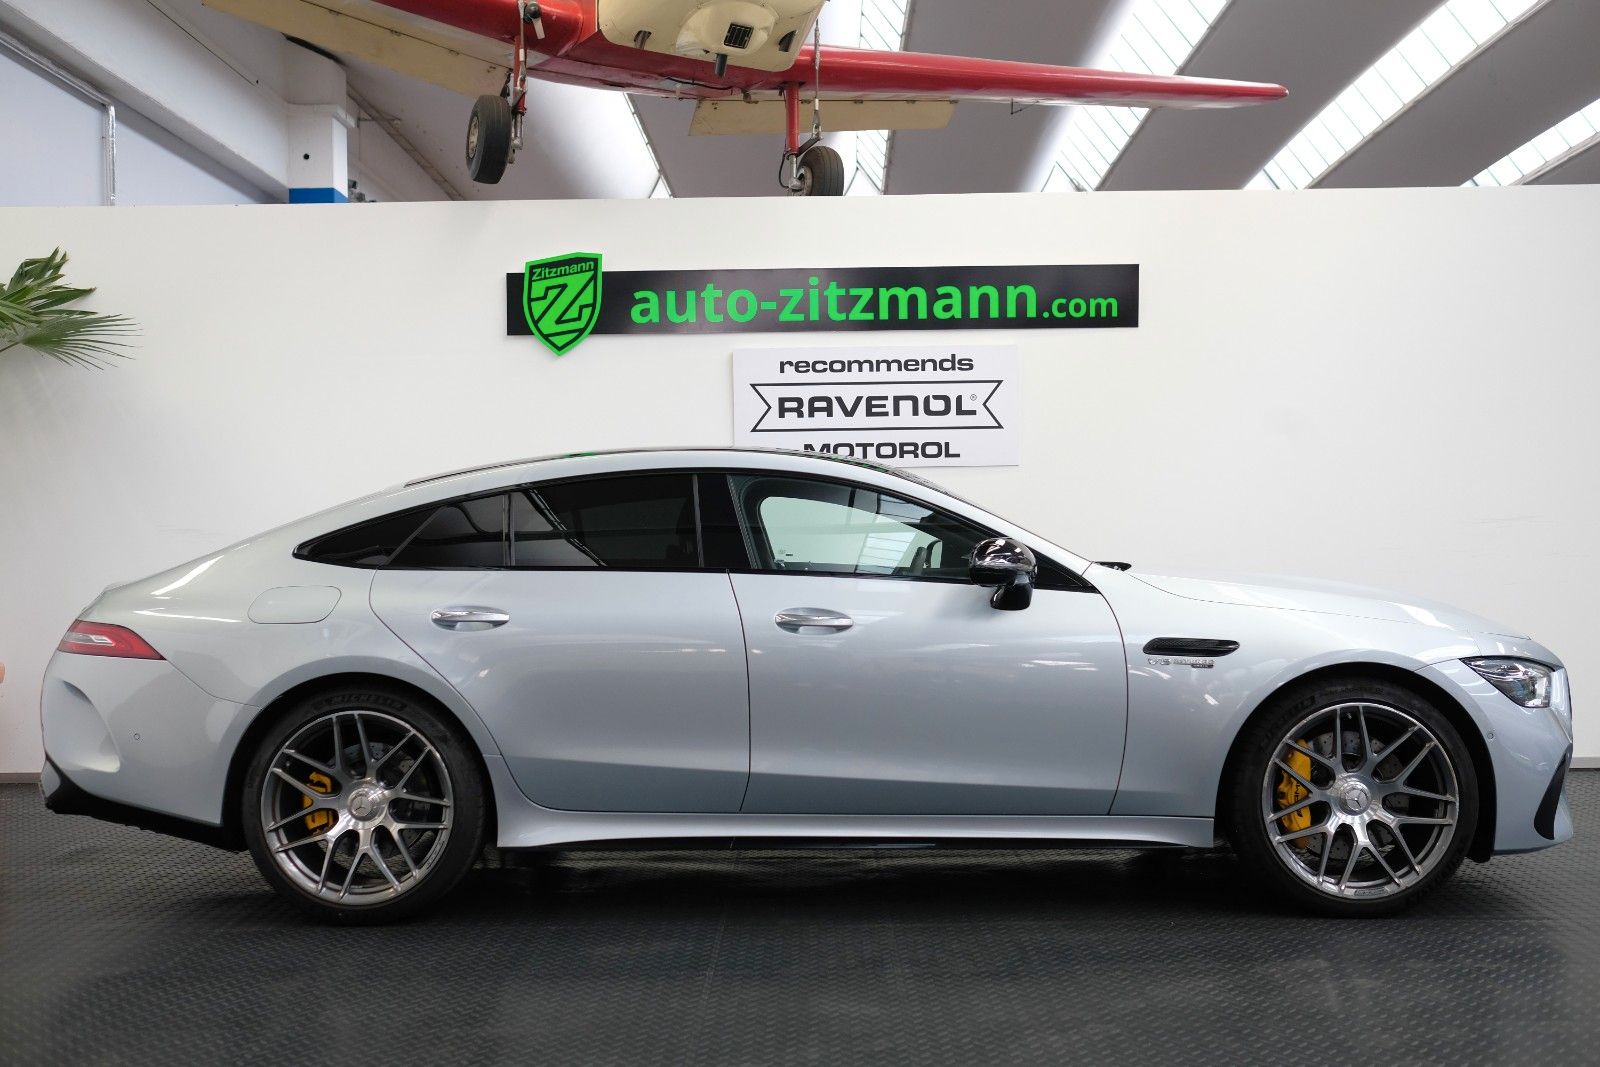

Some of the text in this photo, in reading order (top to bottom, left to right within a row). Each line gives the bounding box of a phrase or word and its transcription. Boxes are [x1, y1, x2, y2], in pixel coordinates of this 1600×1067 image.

[531, 260, 594, 281] Zitzmann
[630, 275, 1118, 325] auto-zitzmann.com
[779, 354, 974, 373] recommends
